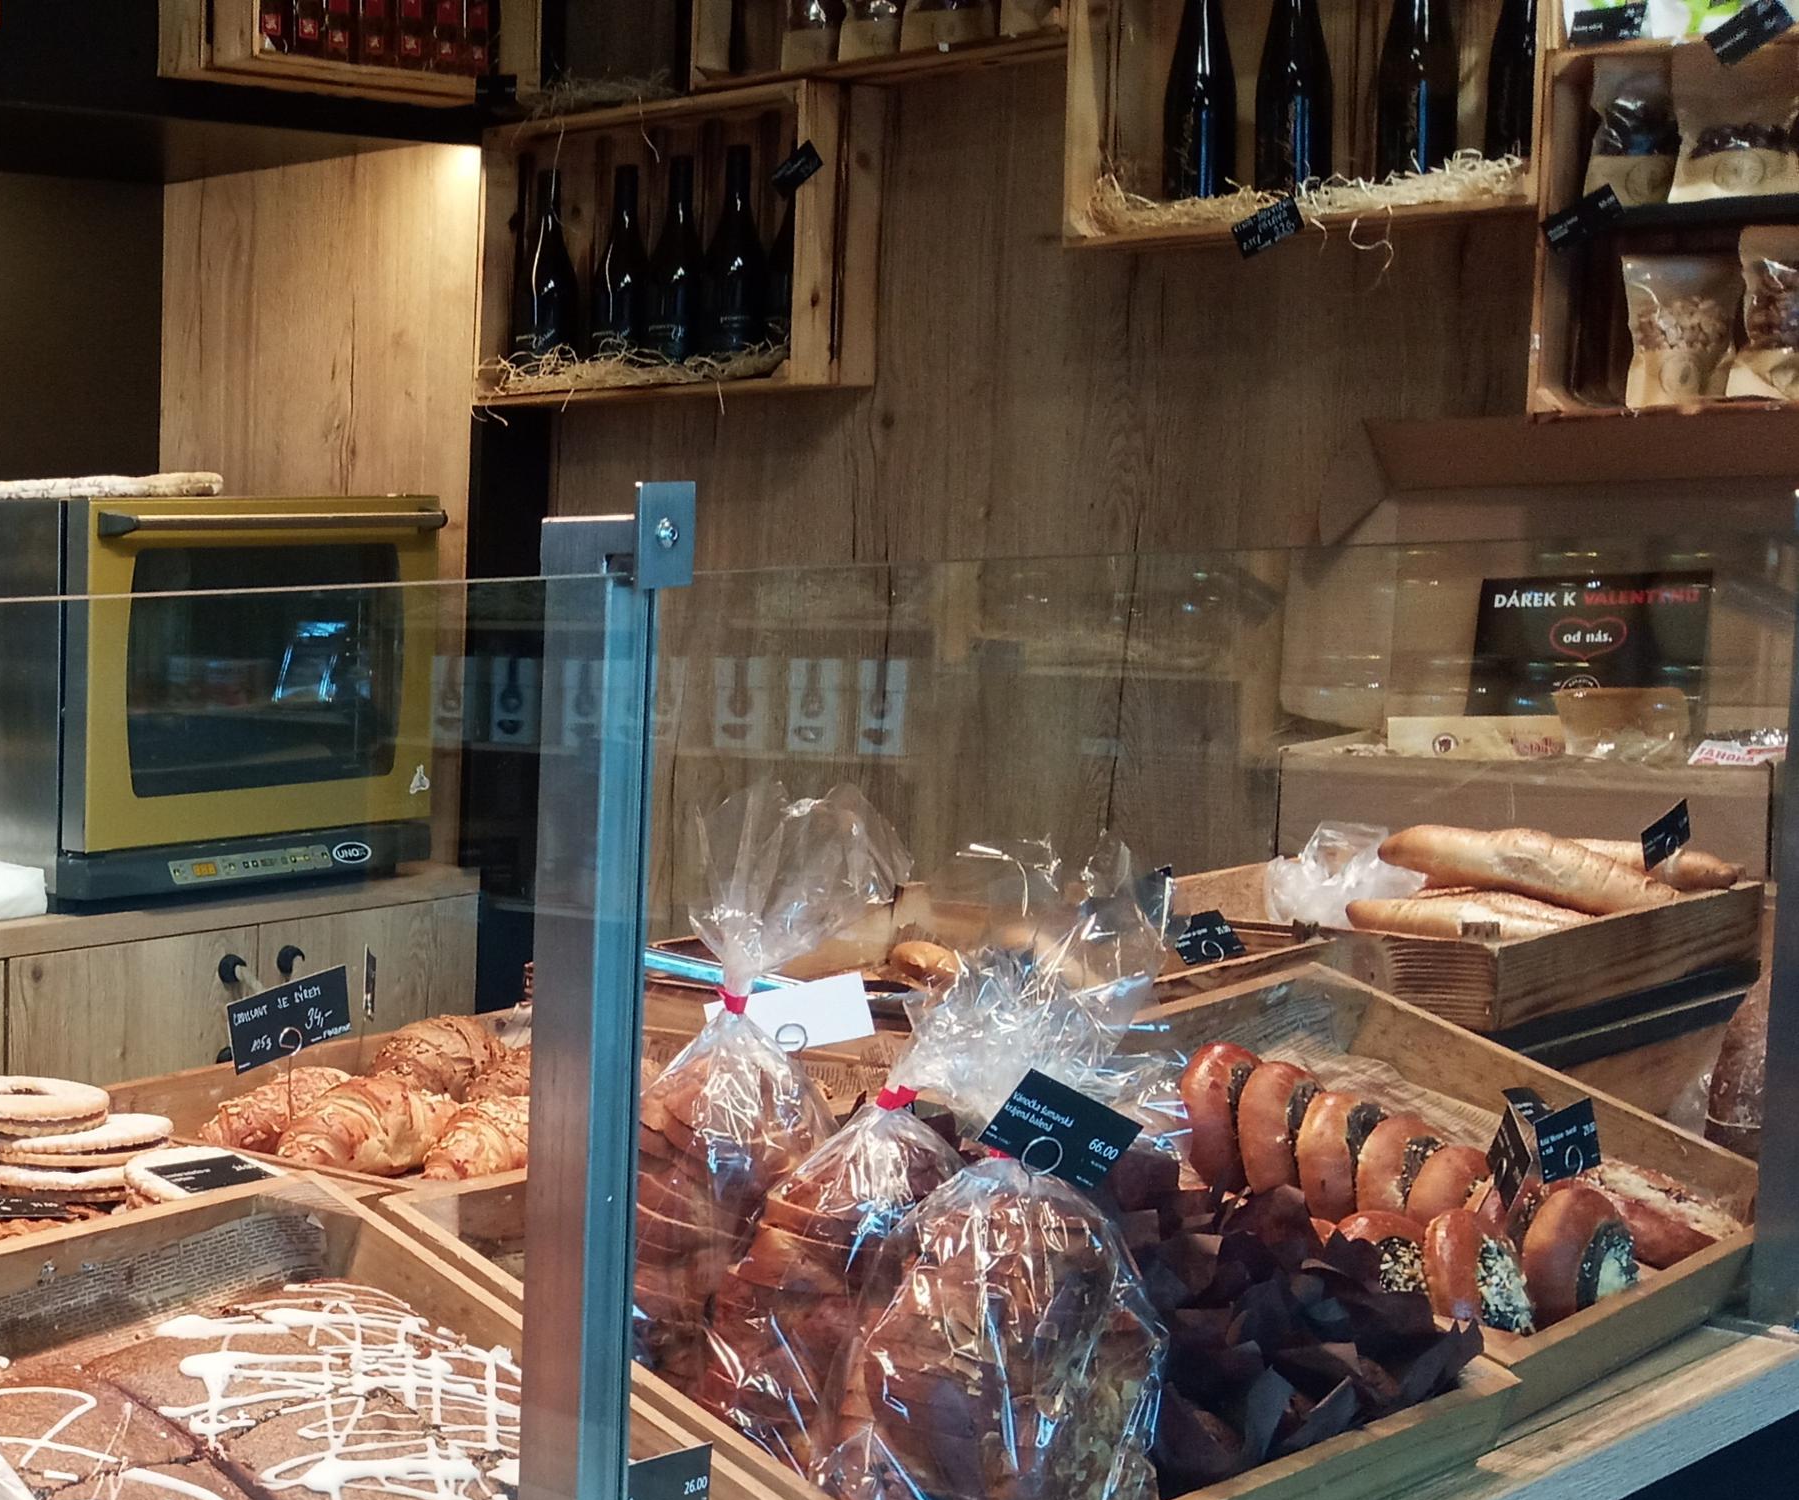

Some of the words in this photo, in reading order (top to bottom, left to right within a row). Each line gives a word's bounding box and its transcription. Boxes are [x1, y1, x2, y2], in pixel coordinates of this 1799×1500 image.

[1494, 590, 1556, 608] DÁREK
[1563, 592, 1577, 607] K
[1563, 631, 1581, 643] od
[1585, 631, 1613, 643] nás.
[1088, 1137, 1119, 1161] 66.00
[684, 1476, 707, 1495] 26.00
